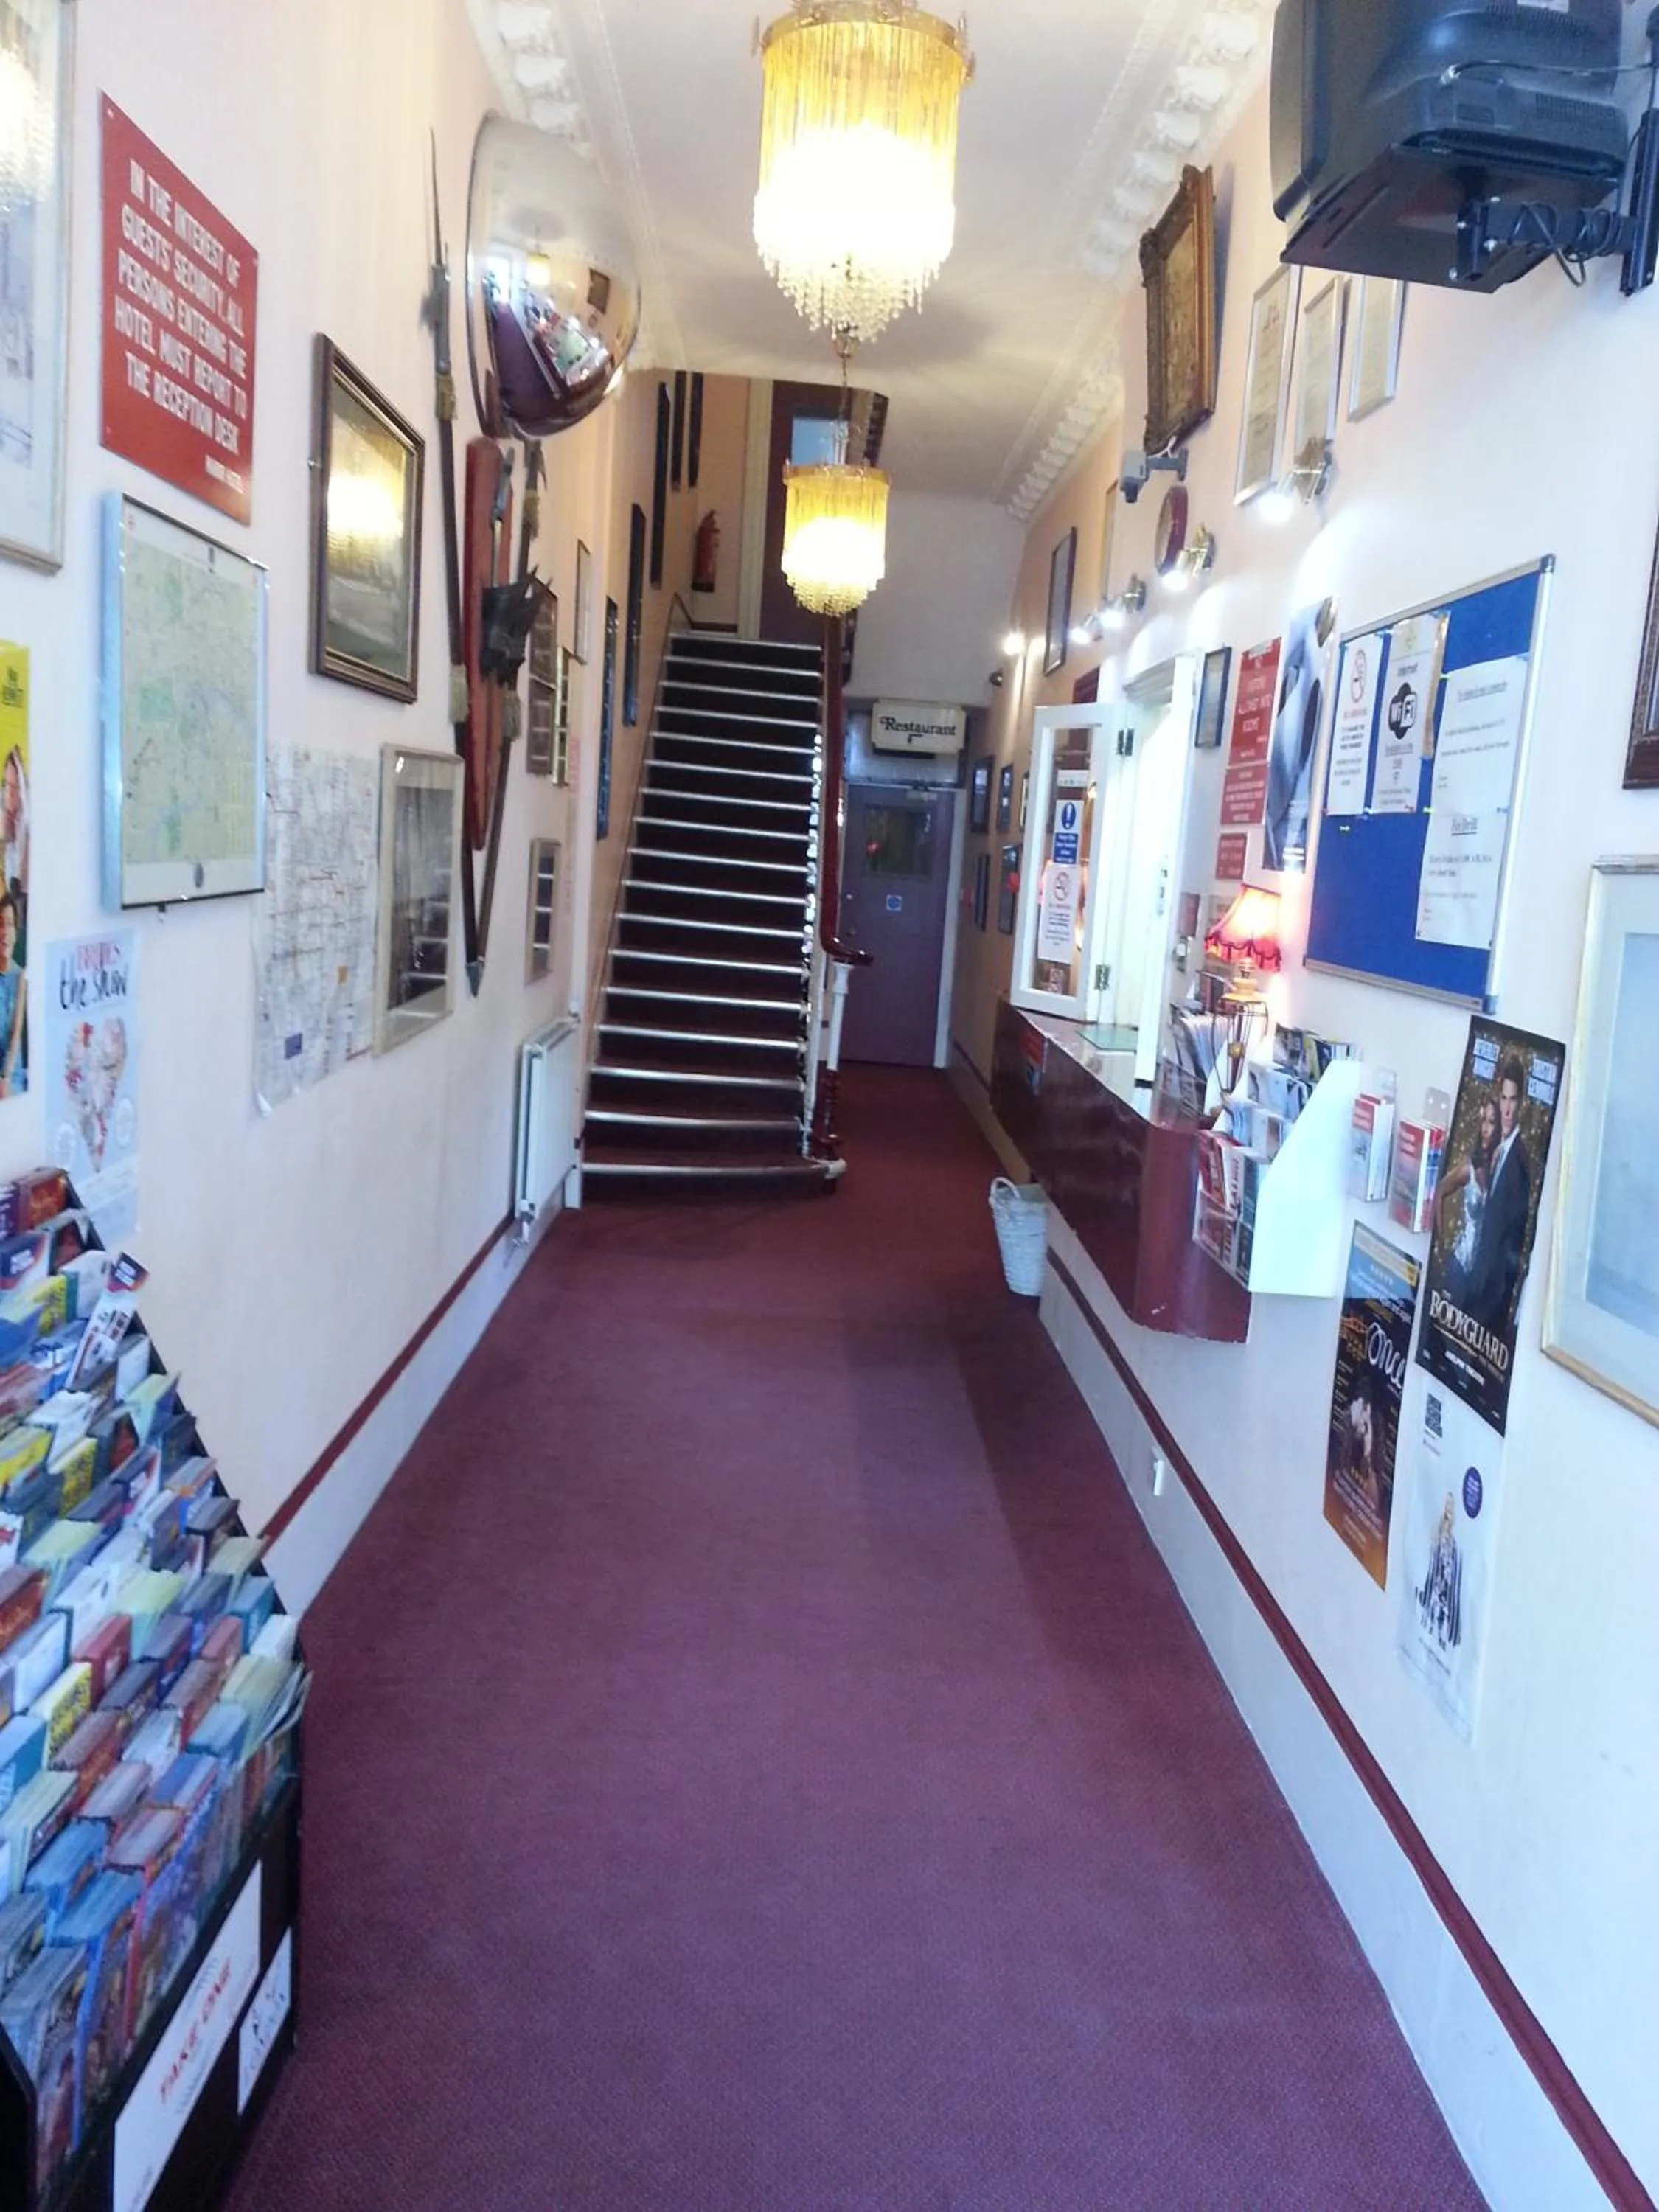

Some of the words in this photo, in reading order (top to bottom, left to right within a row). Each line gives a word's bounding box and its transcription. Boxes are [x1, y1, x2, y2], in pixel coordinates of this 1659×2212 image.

[130, 158, 145, 203] IN
[147, 174, 173, 228] THE
[175, 200, 224, 275] INTEREST
[226, 254, 241, 288] OF
[114, 294, 156, 355] HOTEL
[159, 328, 192, 379] MUST
[194, 353, 233, 408] REPORT
[234, 383, 247, 420] TO
[118, 247, 175, 323] PERSONS
[177, 297, 226, 364] ENTERING
[229, 339, 246, 380] THE
[227, 296, 246, 338] ALL
[125, 349, 150, 398] THE
[153, 370, 213, 439] RECEPTION
[215, 412, 240, 456] DESK
[880, 716, 956, 736] Restaurant
[1429, 1289, 1509, 1371] BODYGUARD
